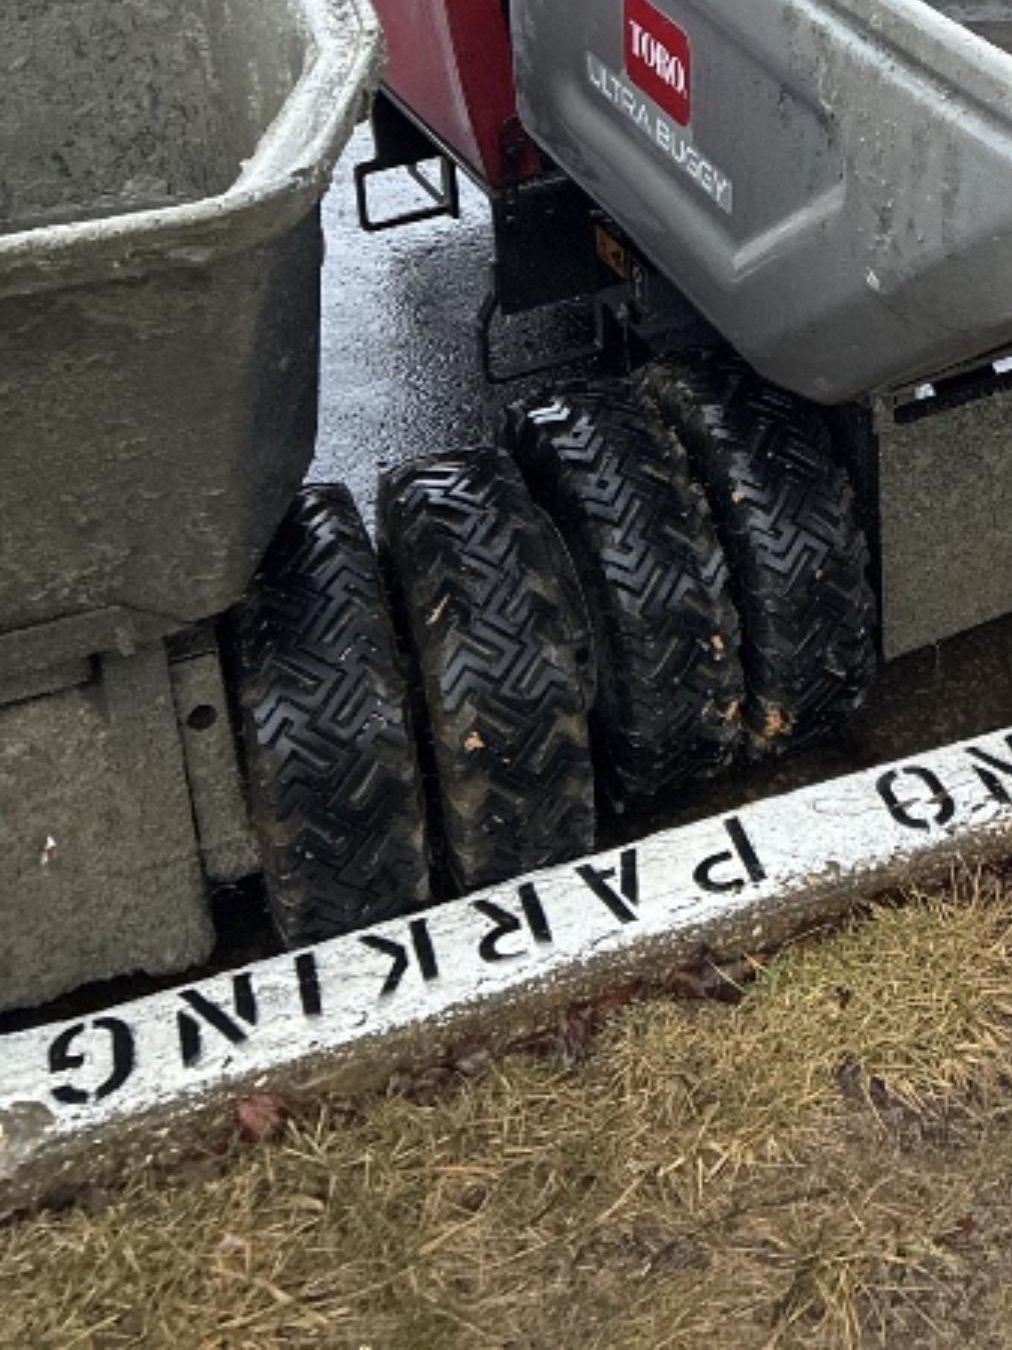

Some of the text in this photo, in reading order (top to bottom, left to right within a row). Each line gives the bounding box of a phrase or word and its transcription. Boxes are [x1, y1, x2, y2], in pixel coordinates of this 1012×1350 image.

[587, 52, 732, 202] ULTRA BUGGY
[629, 19, 686, 94] TORO
[48, 817, 766, 1104] PARKING
